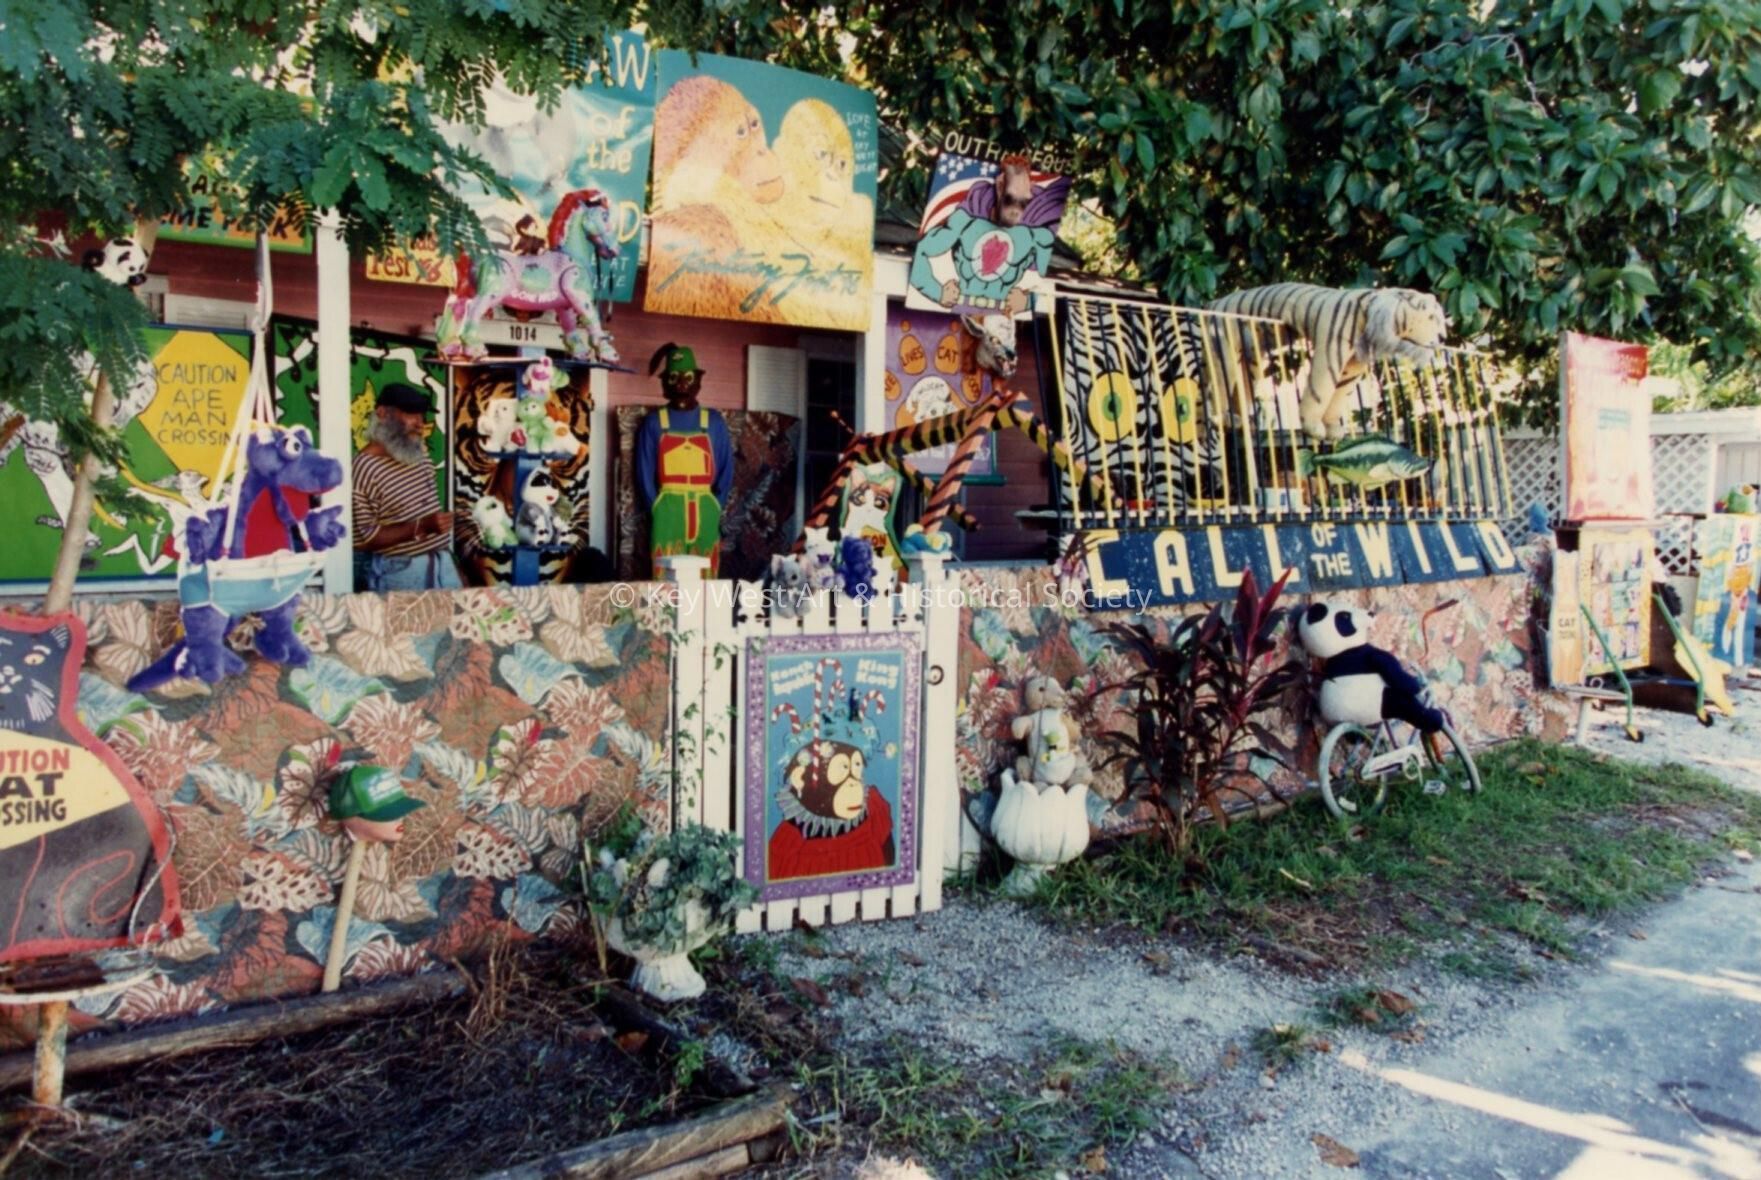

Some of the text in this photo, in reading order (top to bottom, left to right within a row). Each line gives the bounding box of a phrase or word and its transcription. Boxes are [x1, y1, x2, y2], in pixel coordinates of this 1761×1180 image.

[592, 105, 636, 140] of
[587, 138, 632, 175] the
[944, 131, 1073, 174] OUTREOUS
[510, 325, 537, 341] 1014
[937, 345, 958, 364] CAT
[159, 362, 237, 385] CAUTION
[173, 388, 224, 411] APE
[160, 410, 228, 427] MAN
[1083, 519, 1516, 598] CALL OF THE WILD
